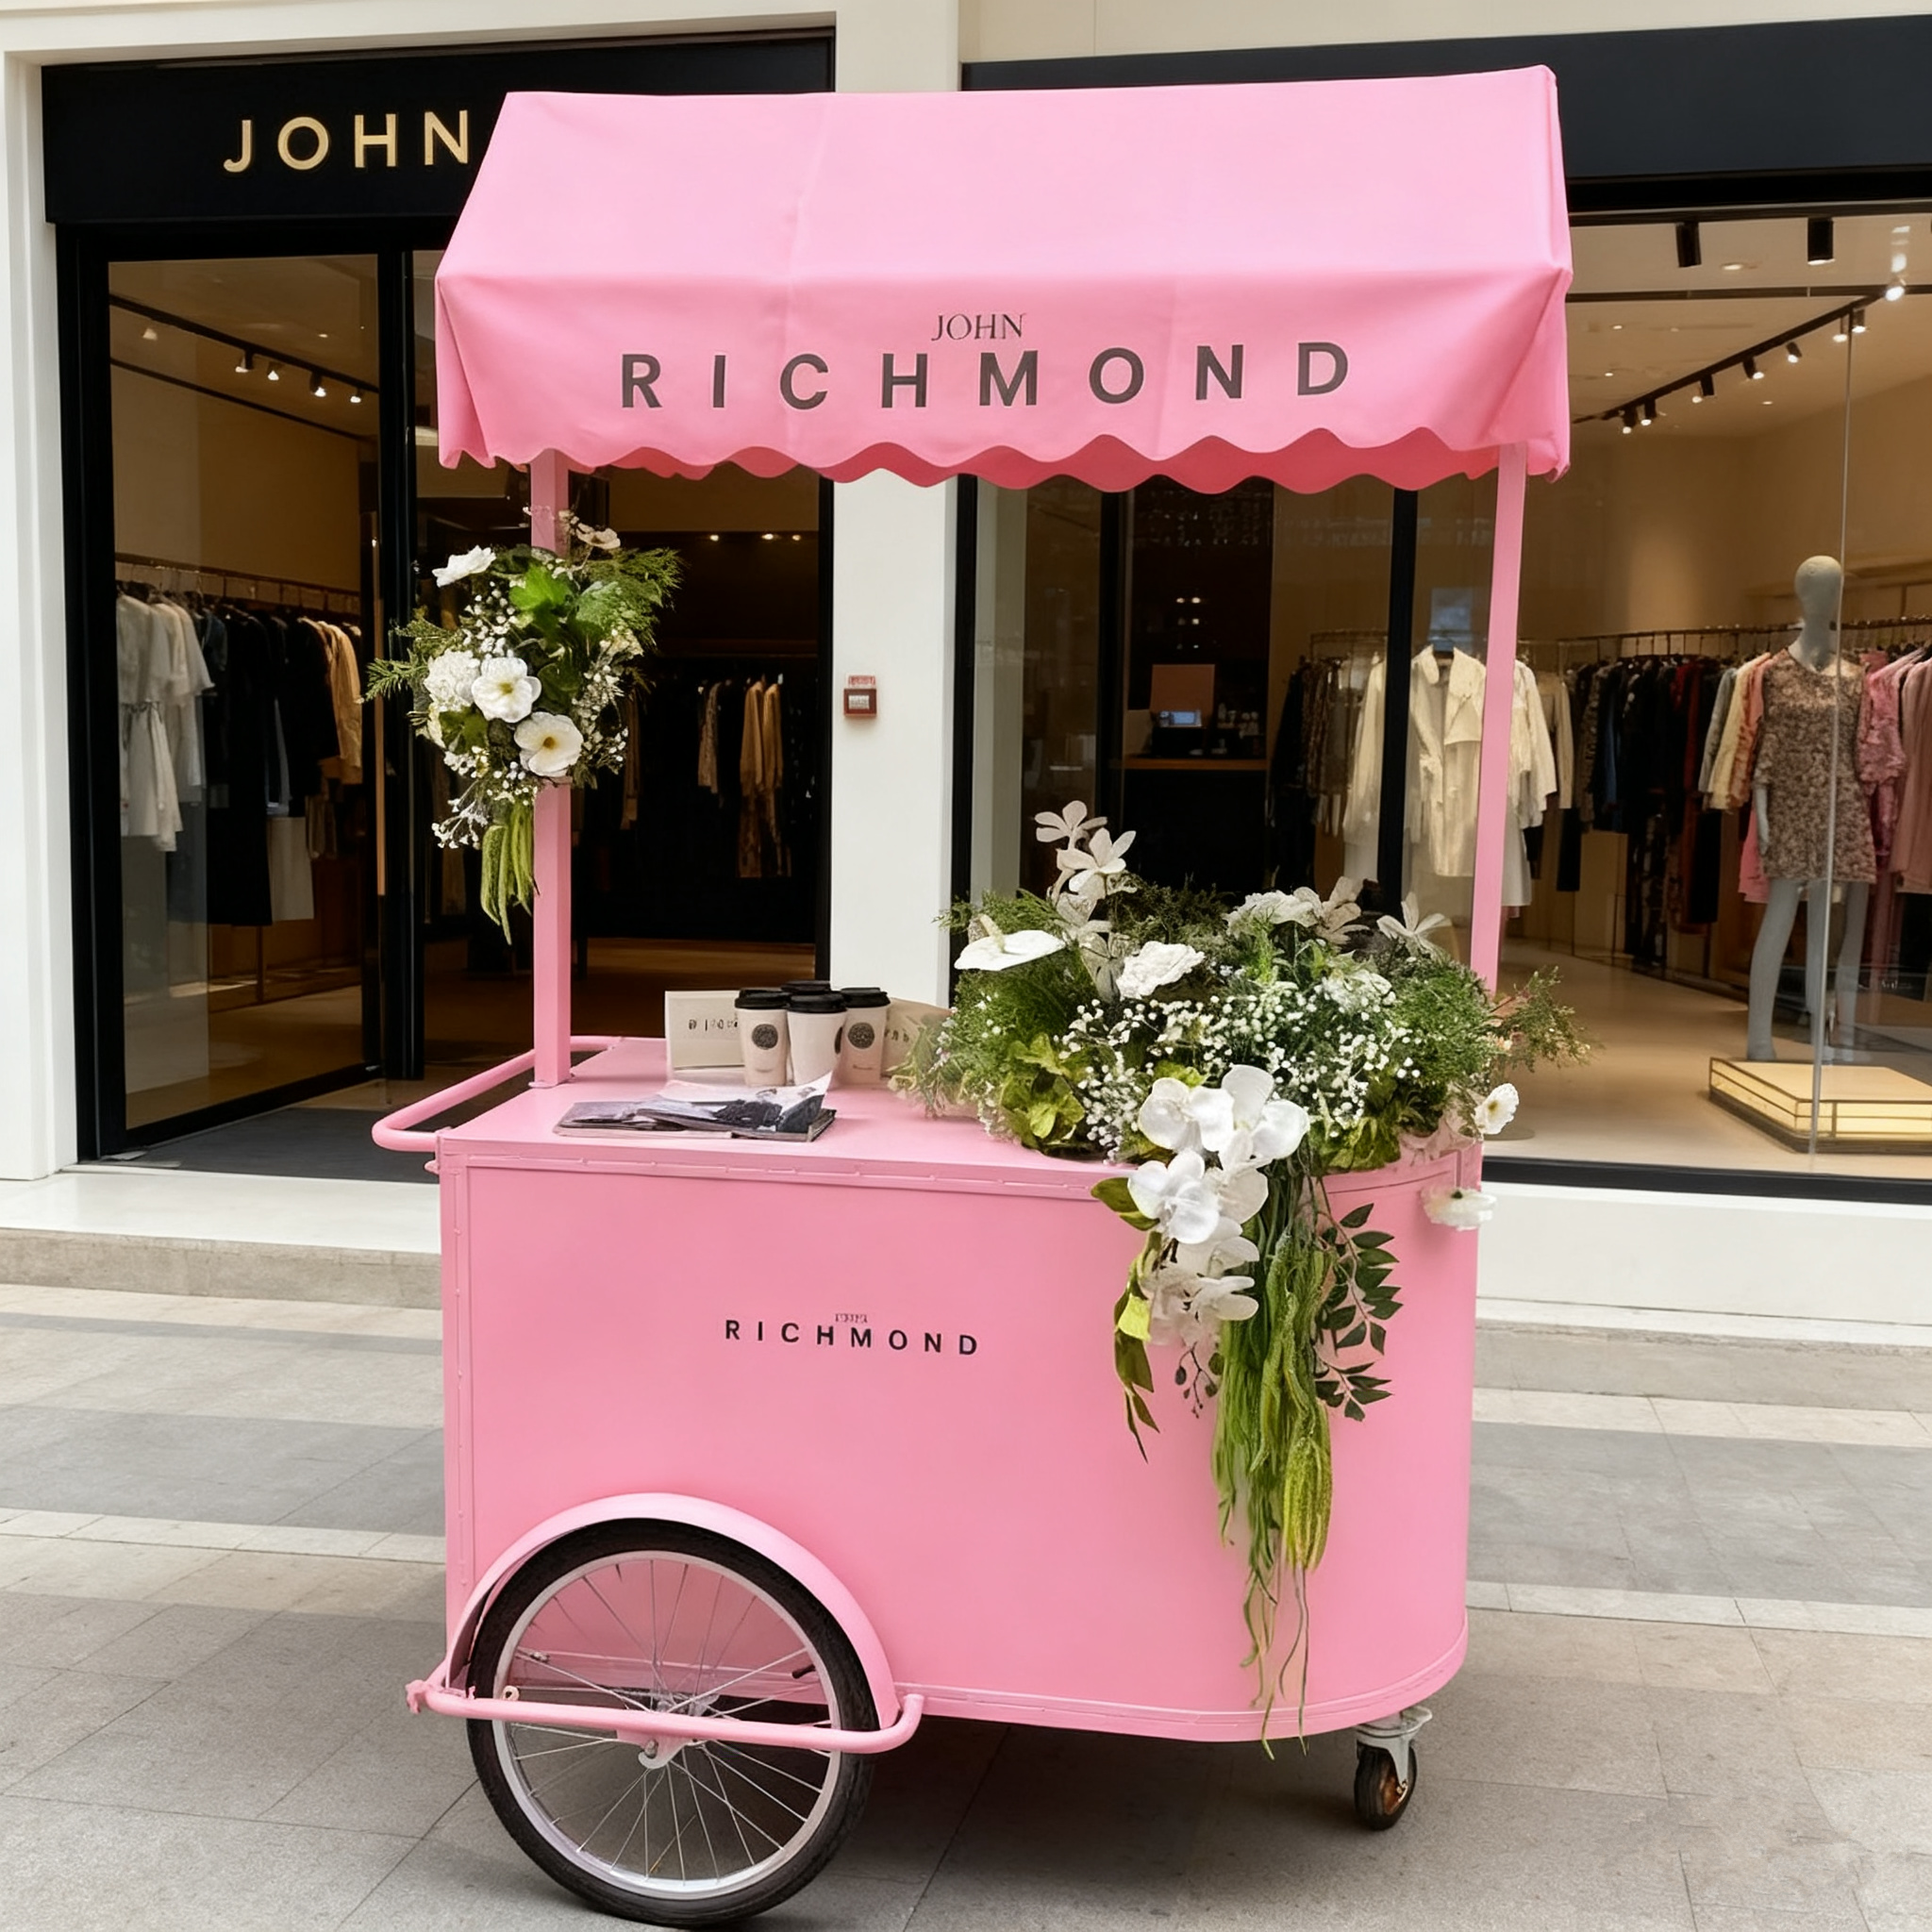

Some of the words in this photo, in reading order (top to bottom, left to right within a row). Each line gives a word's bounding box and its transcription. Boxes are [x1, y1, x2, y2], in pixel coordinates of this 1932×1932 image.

[224, 109, 469, 173] JOHN
[931, 312, 1025, 341] JOHN
[621, 341, 1350, 409] RICHMOND
[725, 1320, 977, 1356] RICHMOND
